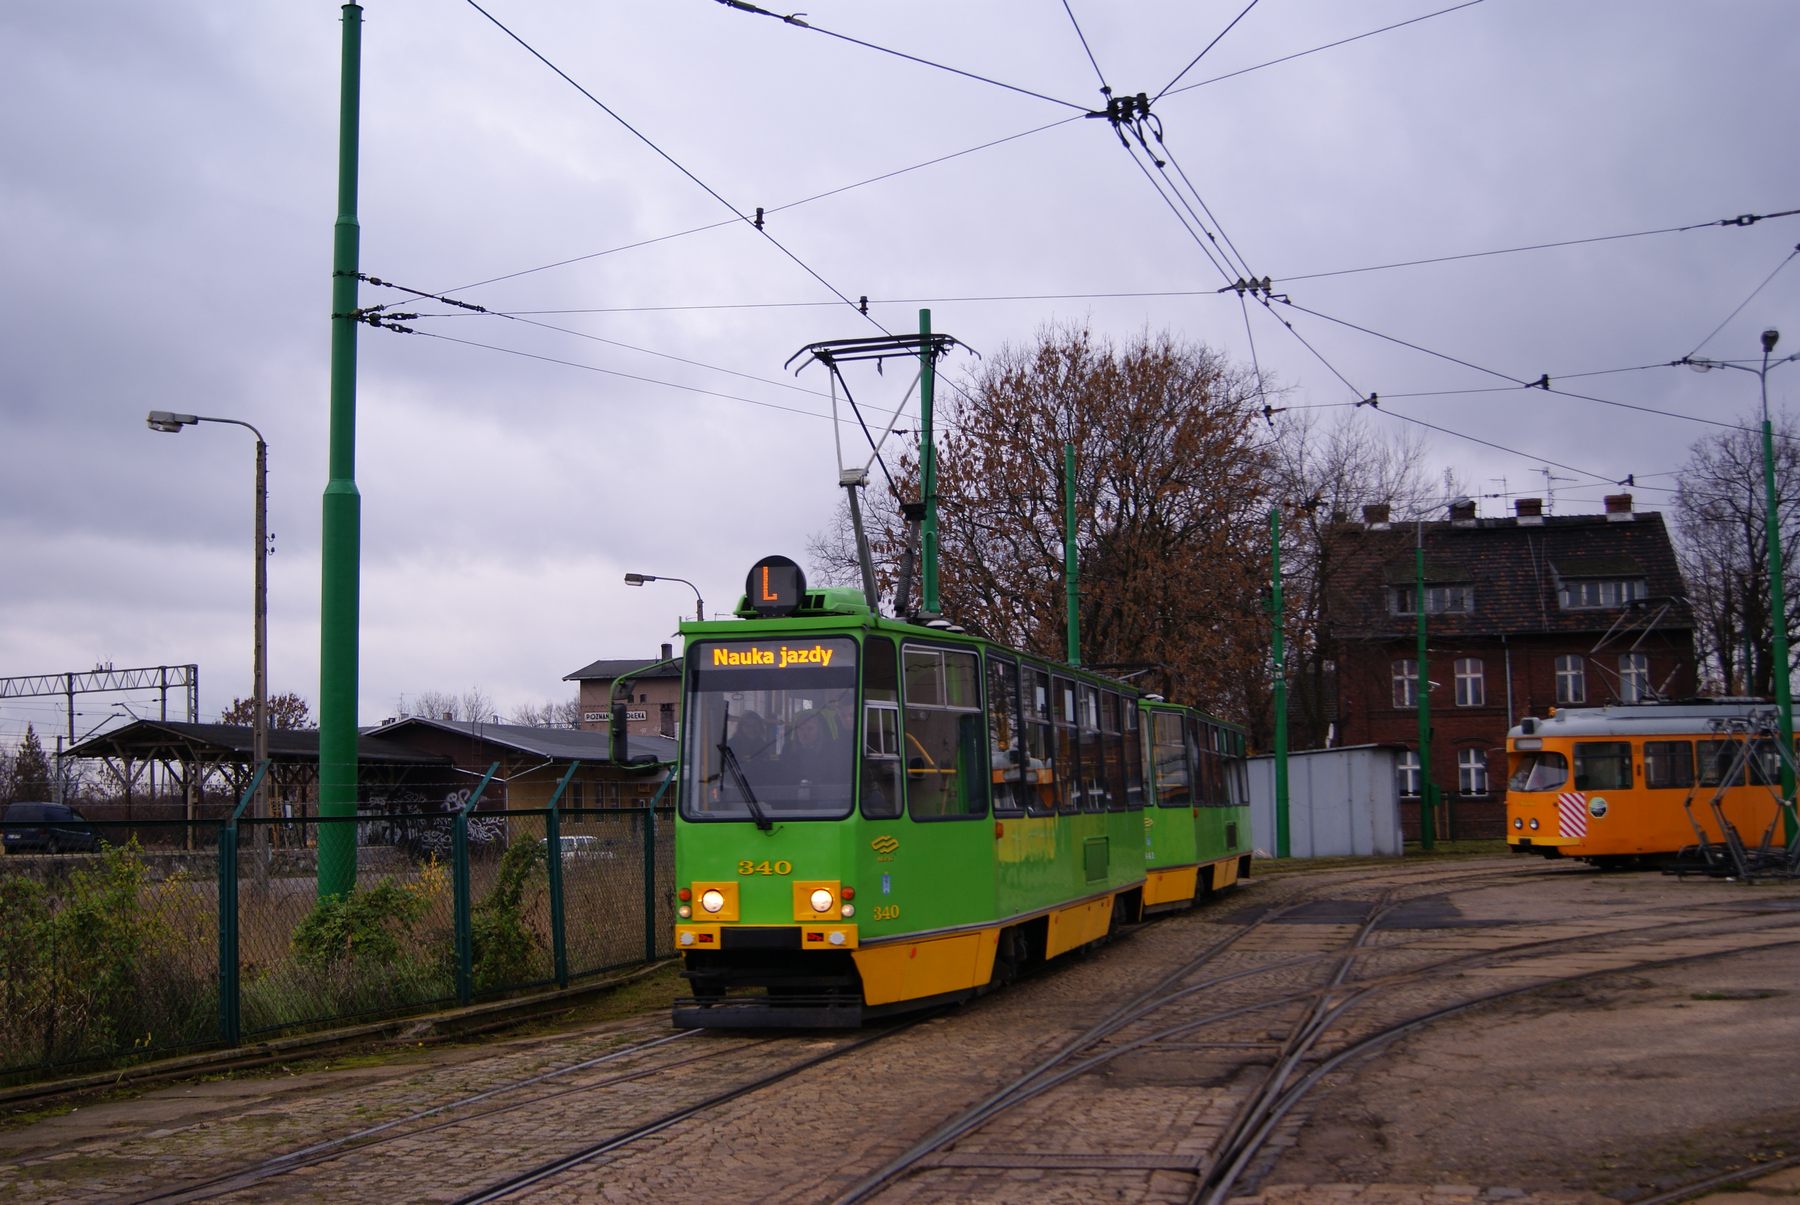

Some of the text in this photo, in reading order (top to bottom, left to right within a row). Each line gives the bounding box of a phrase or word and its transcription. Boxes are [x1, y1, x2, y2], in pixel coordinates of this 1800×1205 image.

[762, 566, 778, 600] L
[713, 645, 833, 668] Nauka jazdy
[738, 860, 792, 876] 340
[873, 904, 900, 920] 340
